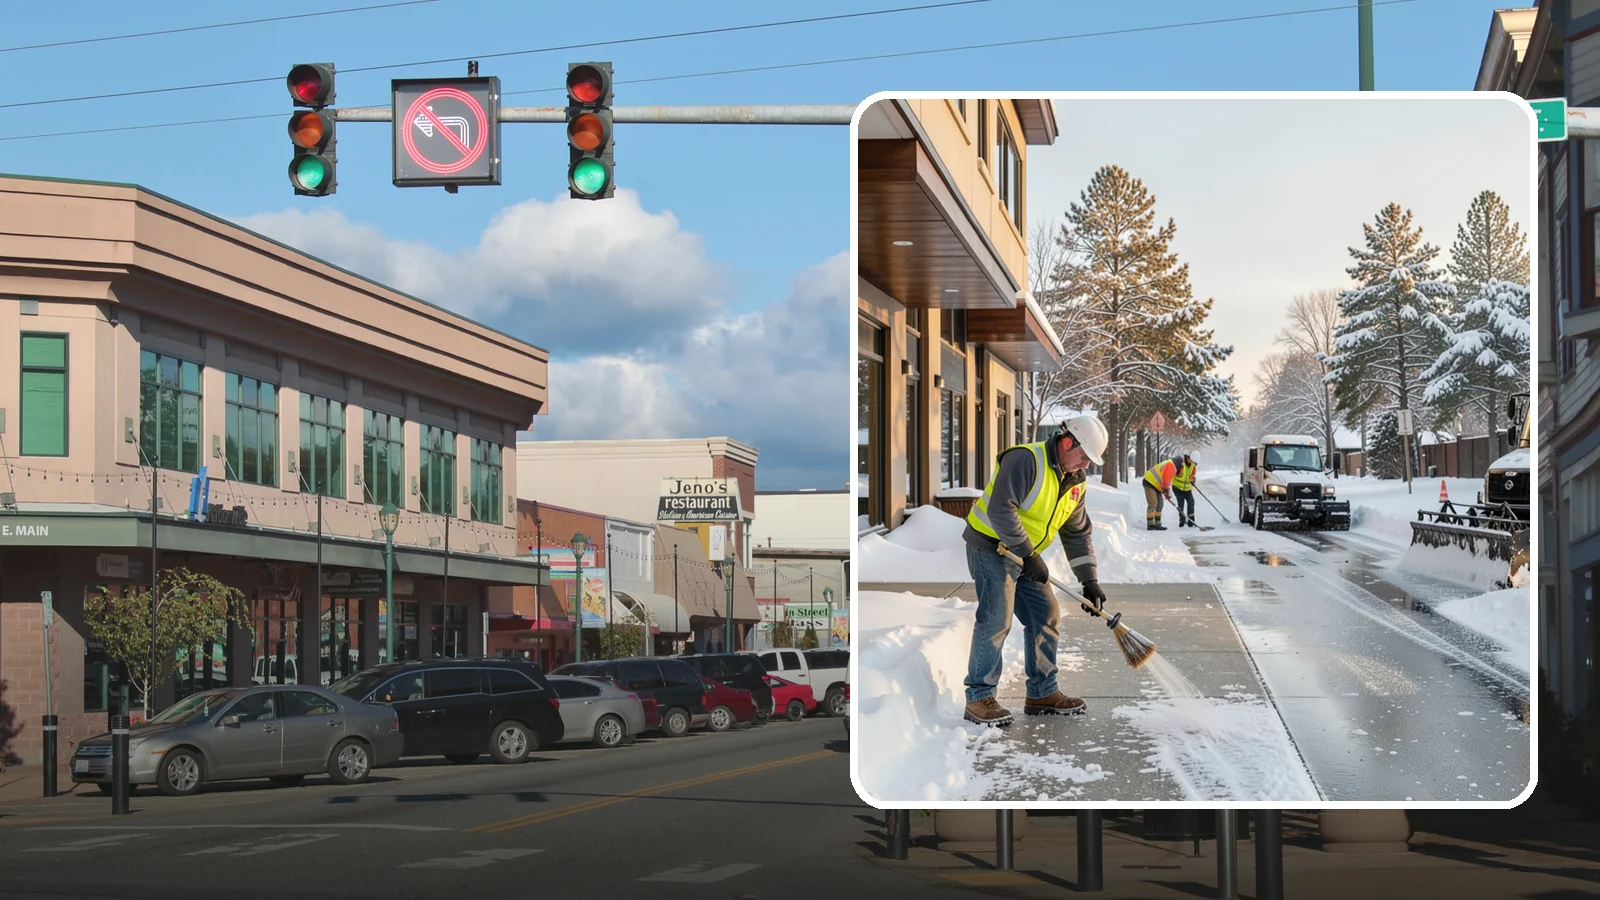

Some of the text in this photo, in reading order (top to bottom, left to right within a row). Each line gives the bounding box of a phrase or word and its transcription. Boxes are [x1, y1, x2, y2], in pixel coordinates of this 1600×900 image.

[670, 479, 727, 494] Jeno's
[665, 496, 731, 509] restaurant
[658, 510, 681, 519] Italian
[686, 510, 714, 519] American
[715, 510, 737, 519] Cuisine
[2, 525, 49, 536] E. MAIN
[797, 607, 828, 617] Street
[791, 619, 824, 627] lass
